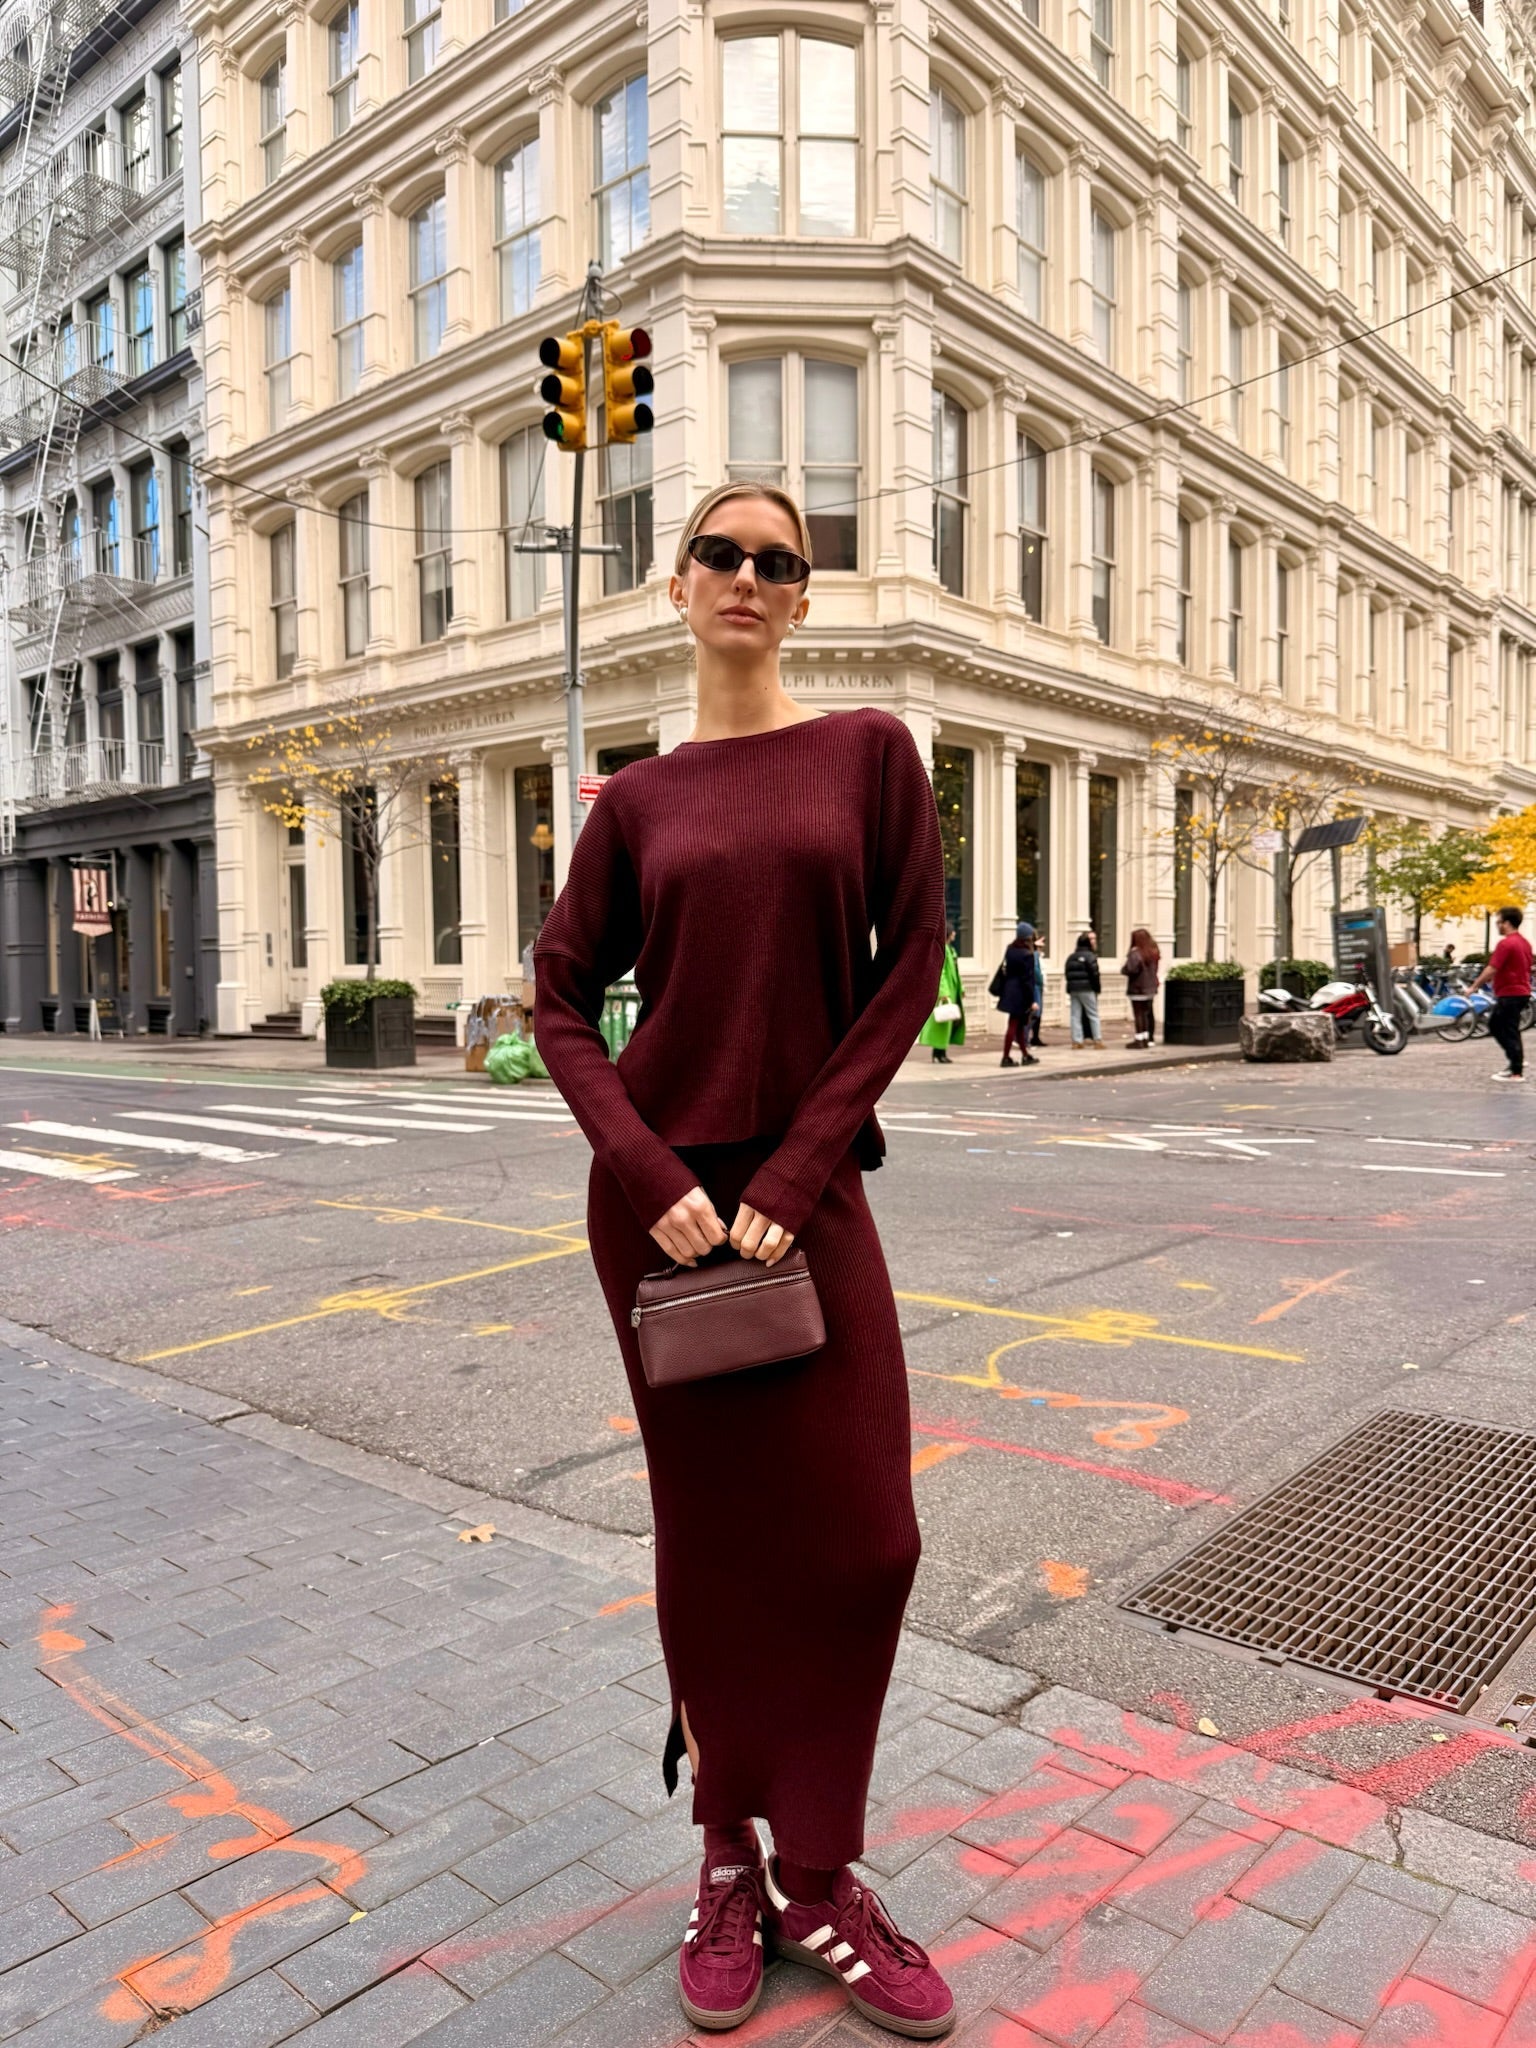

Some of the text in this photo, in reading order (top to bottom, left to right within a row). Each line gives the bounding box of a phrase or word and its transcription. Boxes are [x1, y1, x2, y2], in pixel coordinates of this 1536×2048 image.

[825, 674, 894, 689] LAUREN
[414, 726, 438, 740] POLO
[475, 711, 516, 728] LAUREN
[711, 1868, 737, 1878] adidas
